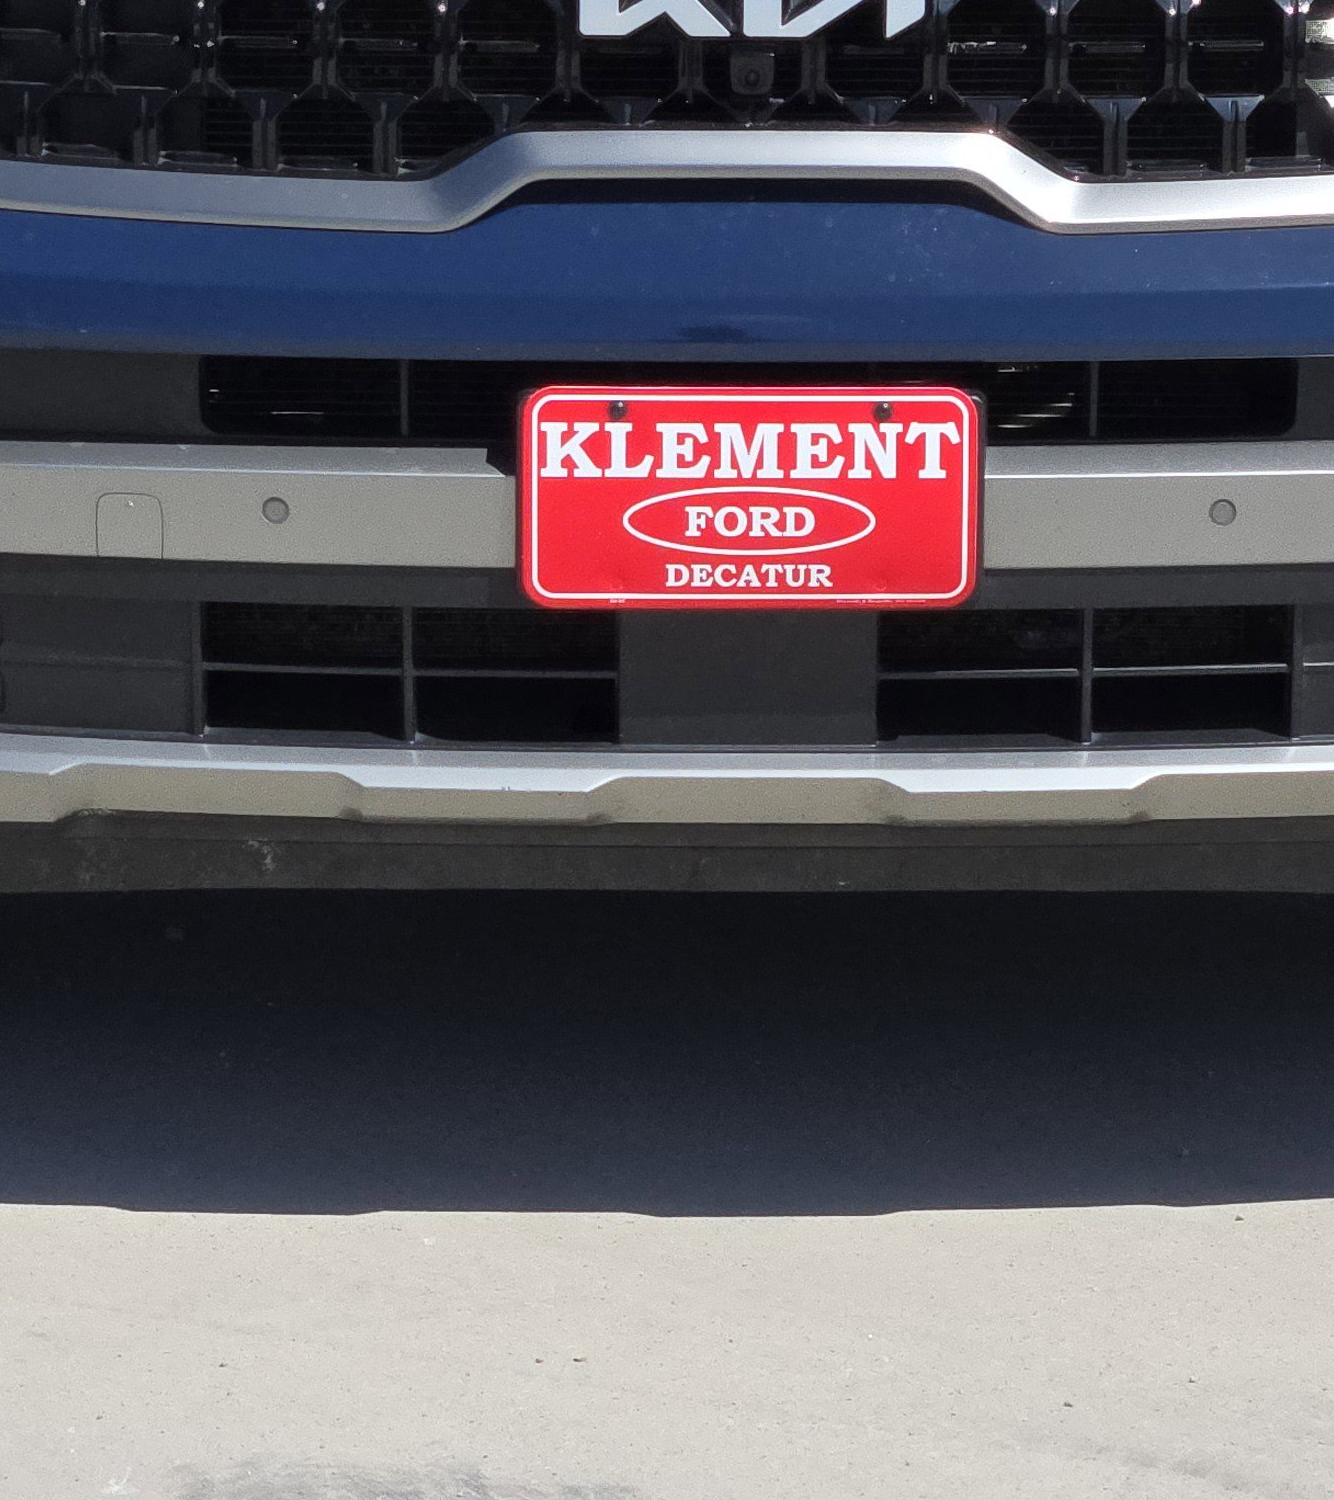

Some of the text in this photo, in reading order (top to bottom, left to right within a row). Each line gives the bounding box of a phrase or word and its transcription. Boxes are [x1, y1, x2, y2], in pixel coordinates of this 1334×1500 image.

[539, 420, 961, 480] KLEMENT
[683, 505, 816, 538] FORD
[664, 562, 834, 589] DECATUR
